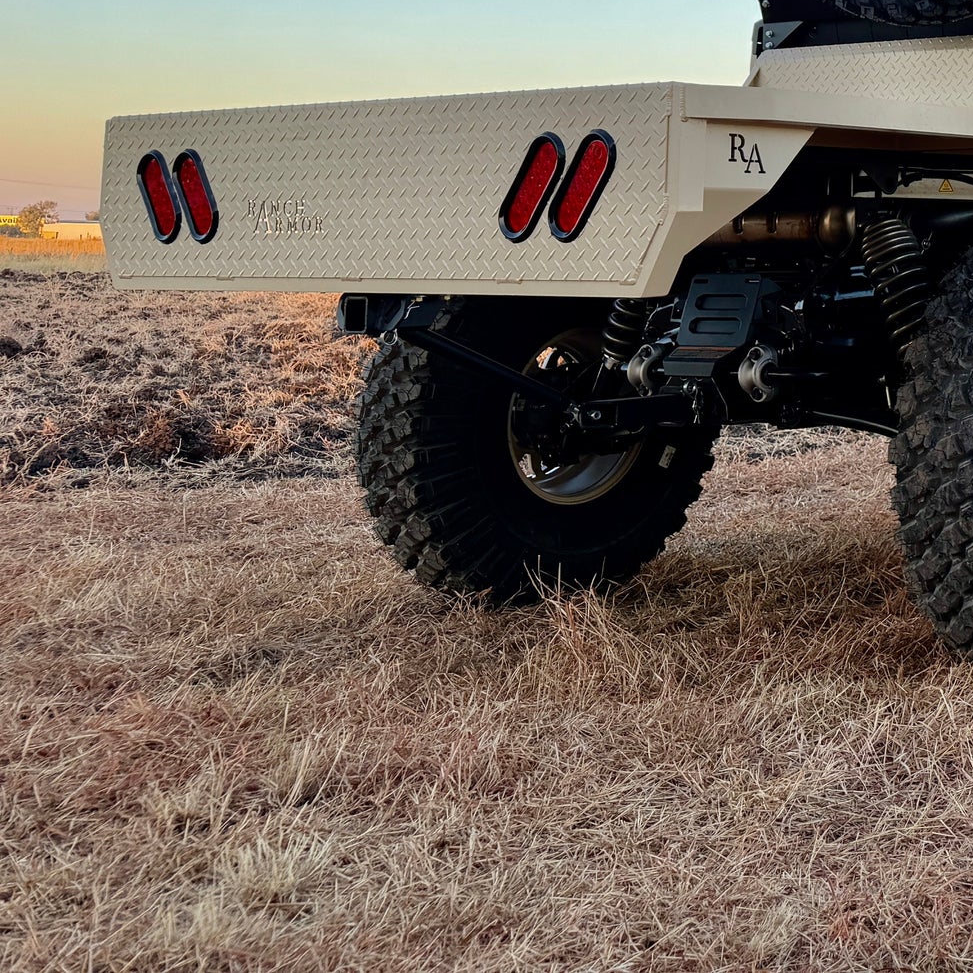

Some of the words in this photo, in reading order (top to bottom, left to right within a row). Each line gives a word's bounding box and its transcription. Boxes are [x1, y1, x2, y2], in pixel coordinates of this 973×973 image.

[728, 133, 766, 174] RA
[248, 200, 305, 217] RANCH
[253, 201, 325, 233] ARMOR
